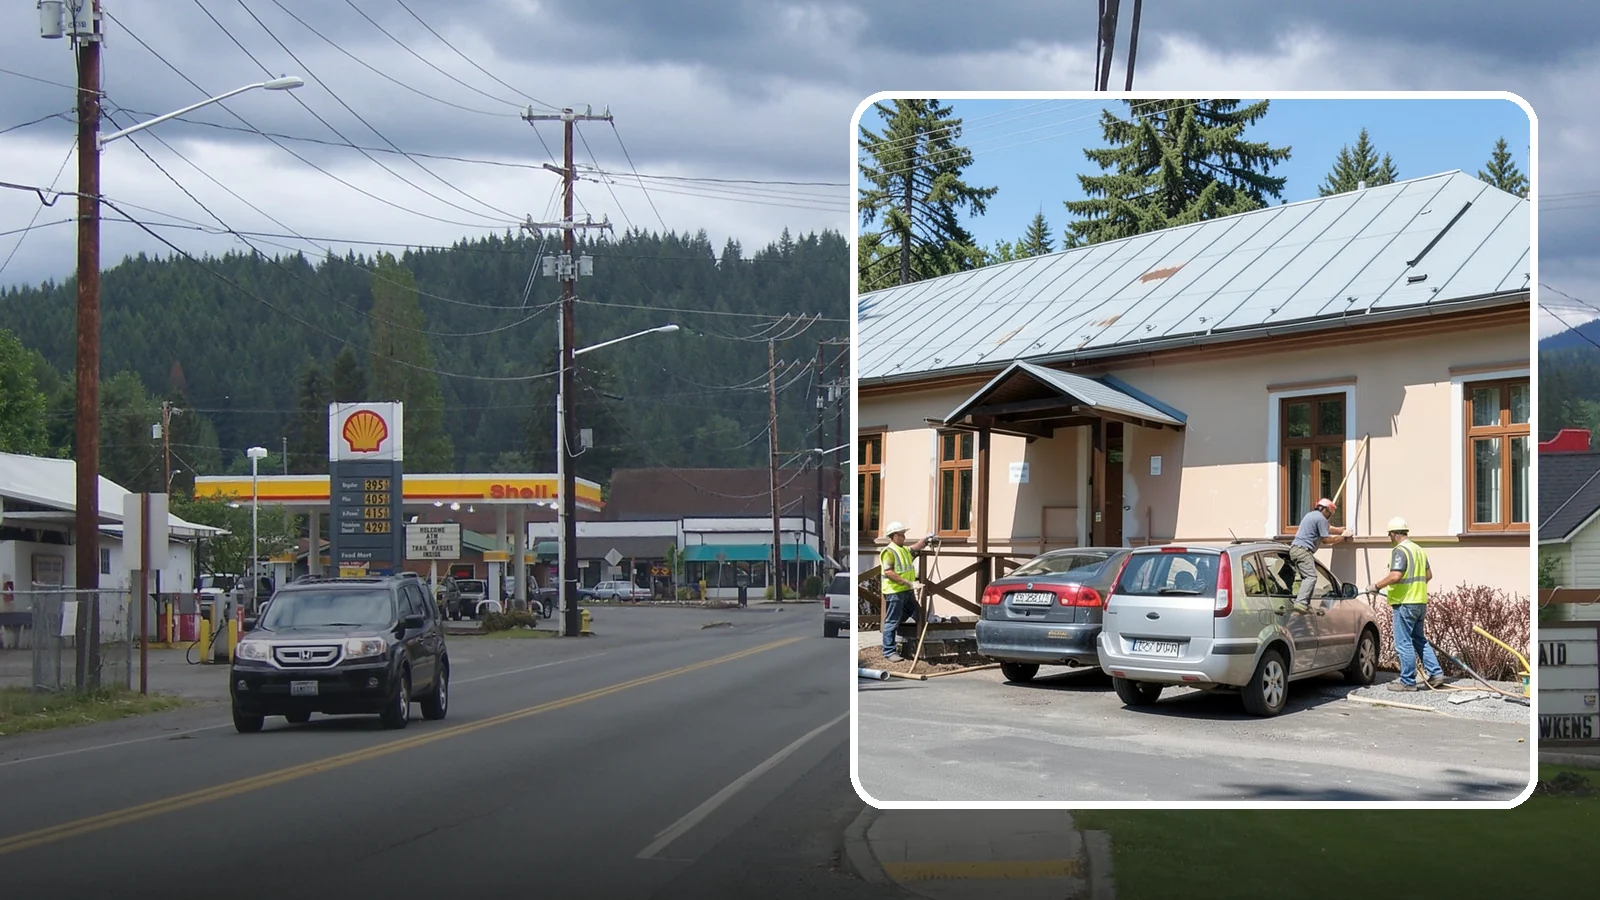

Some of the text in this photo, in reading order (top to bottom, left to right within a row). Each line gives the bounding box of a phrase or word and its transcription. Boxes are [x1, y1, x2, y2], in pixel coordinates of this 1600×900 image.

[365, 480, 384, 490] 395
[490, 484, 547, 499] Shell
[365, 494, 384, 504] 405
[365, 508, 384, 518] 415
[365, 522, 384, 532] 429
